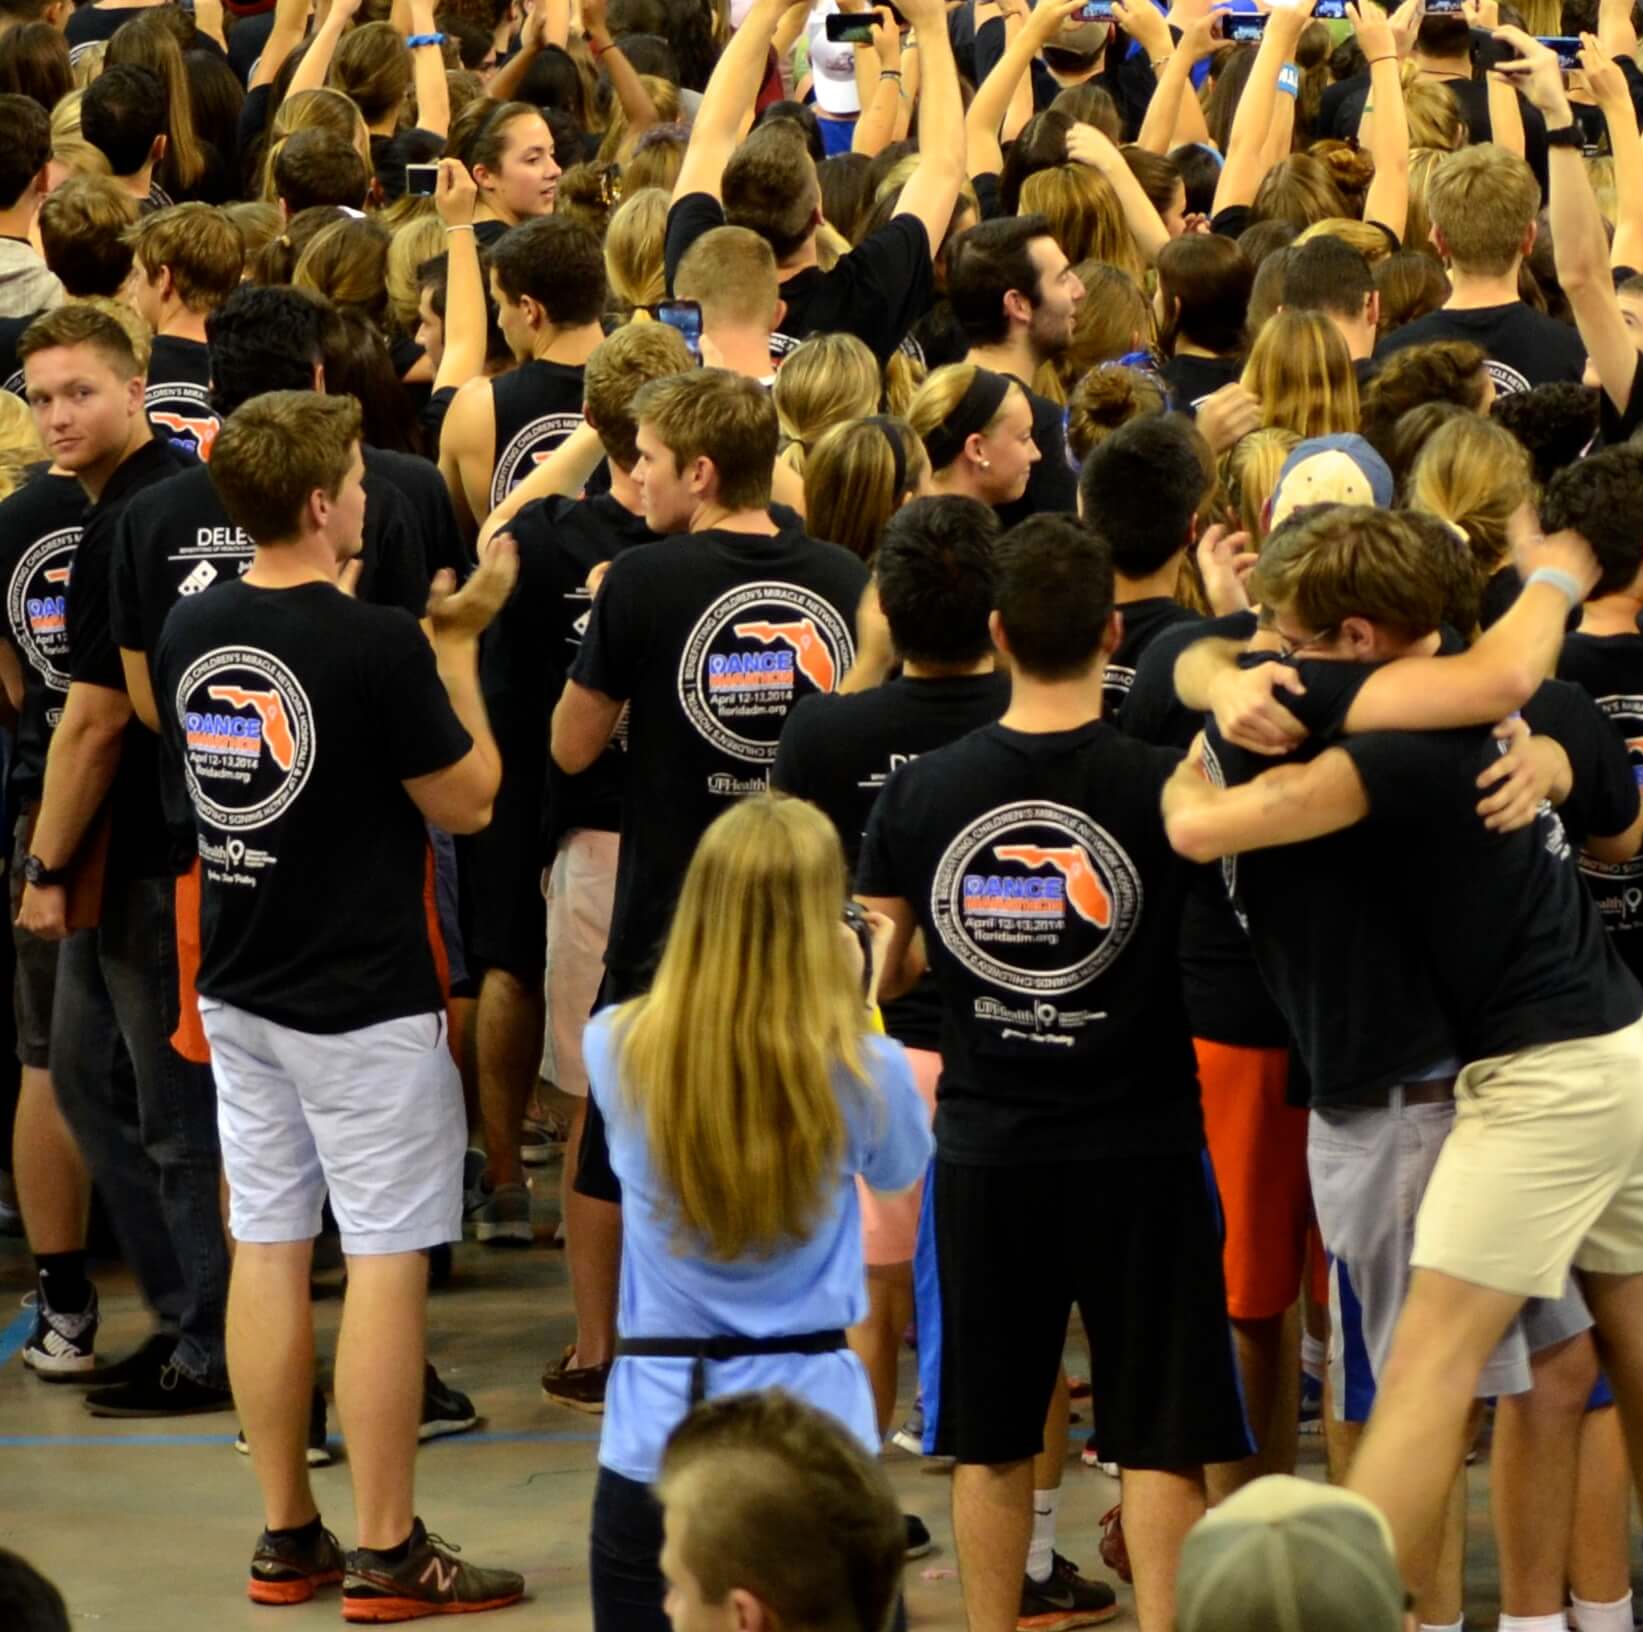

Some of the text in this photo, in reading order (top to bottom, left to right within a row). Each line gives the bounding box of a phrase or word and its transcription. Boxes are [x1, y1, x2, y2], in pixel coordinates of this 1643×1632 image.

[684, 618, 717, 680] BENEFITTING
[714, 588, 763, 618] CHILDREN'S
[763, 587, 806, 606] MIRACLE
[708, 650, 795, 676] DANCE
[710, 693, 736, 706] April
[186, 712, 262, 739] DANCE
[963, 874, 1066, 900] DANCE
[964, 917, 995, 930] April
